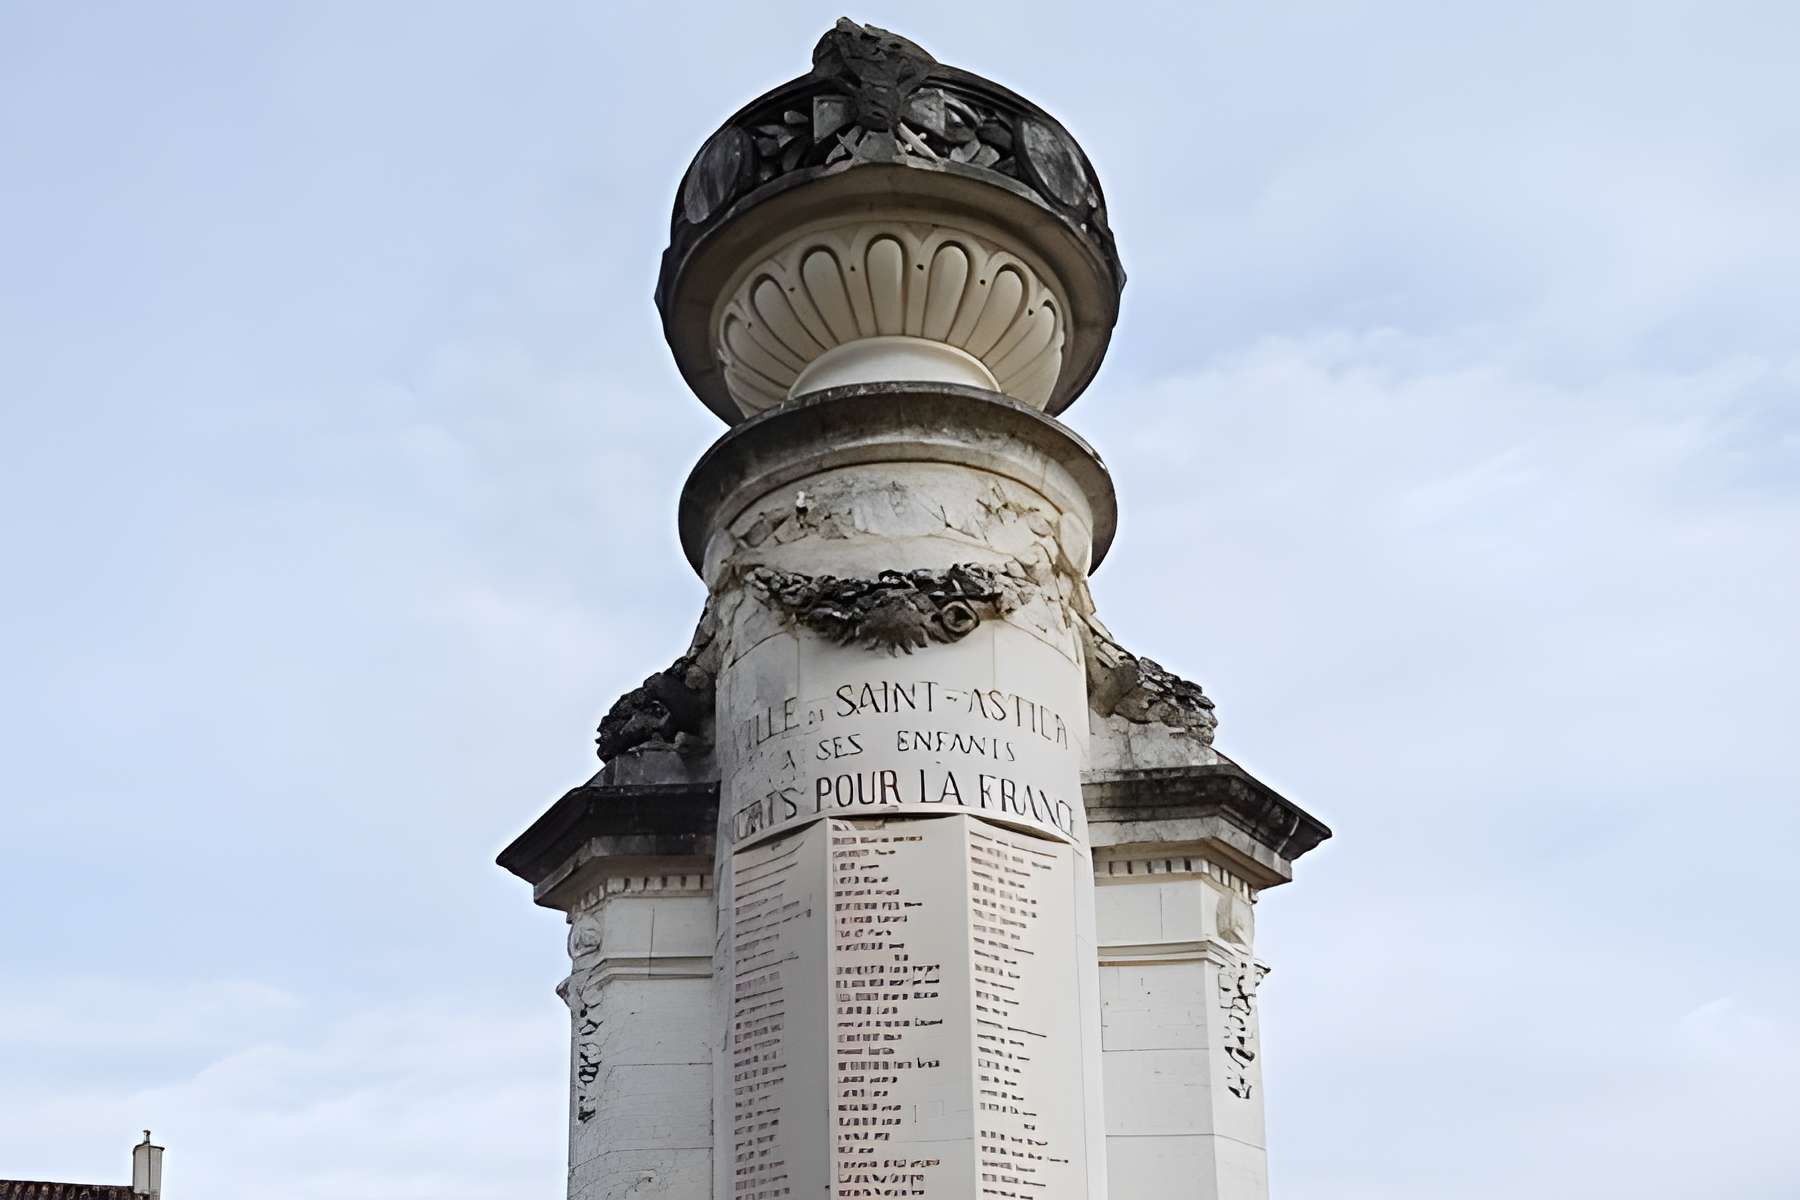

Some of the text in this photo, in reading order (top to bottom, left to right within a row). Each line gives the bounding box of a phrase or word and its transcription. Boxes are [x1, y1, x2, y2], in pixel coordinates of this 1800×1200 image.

[816, 733, 864, 761] SES
[815, 769, 903, 812] POUR
[919, 768, 965, 806] LA
